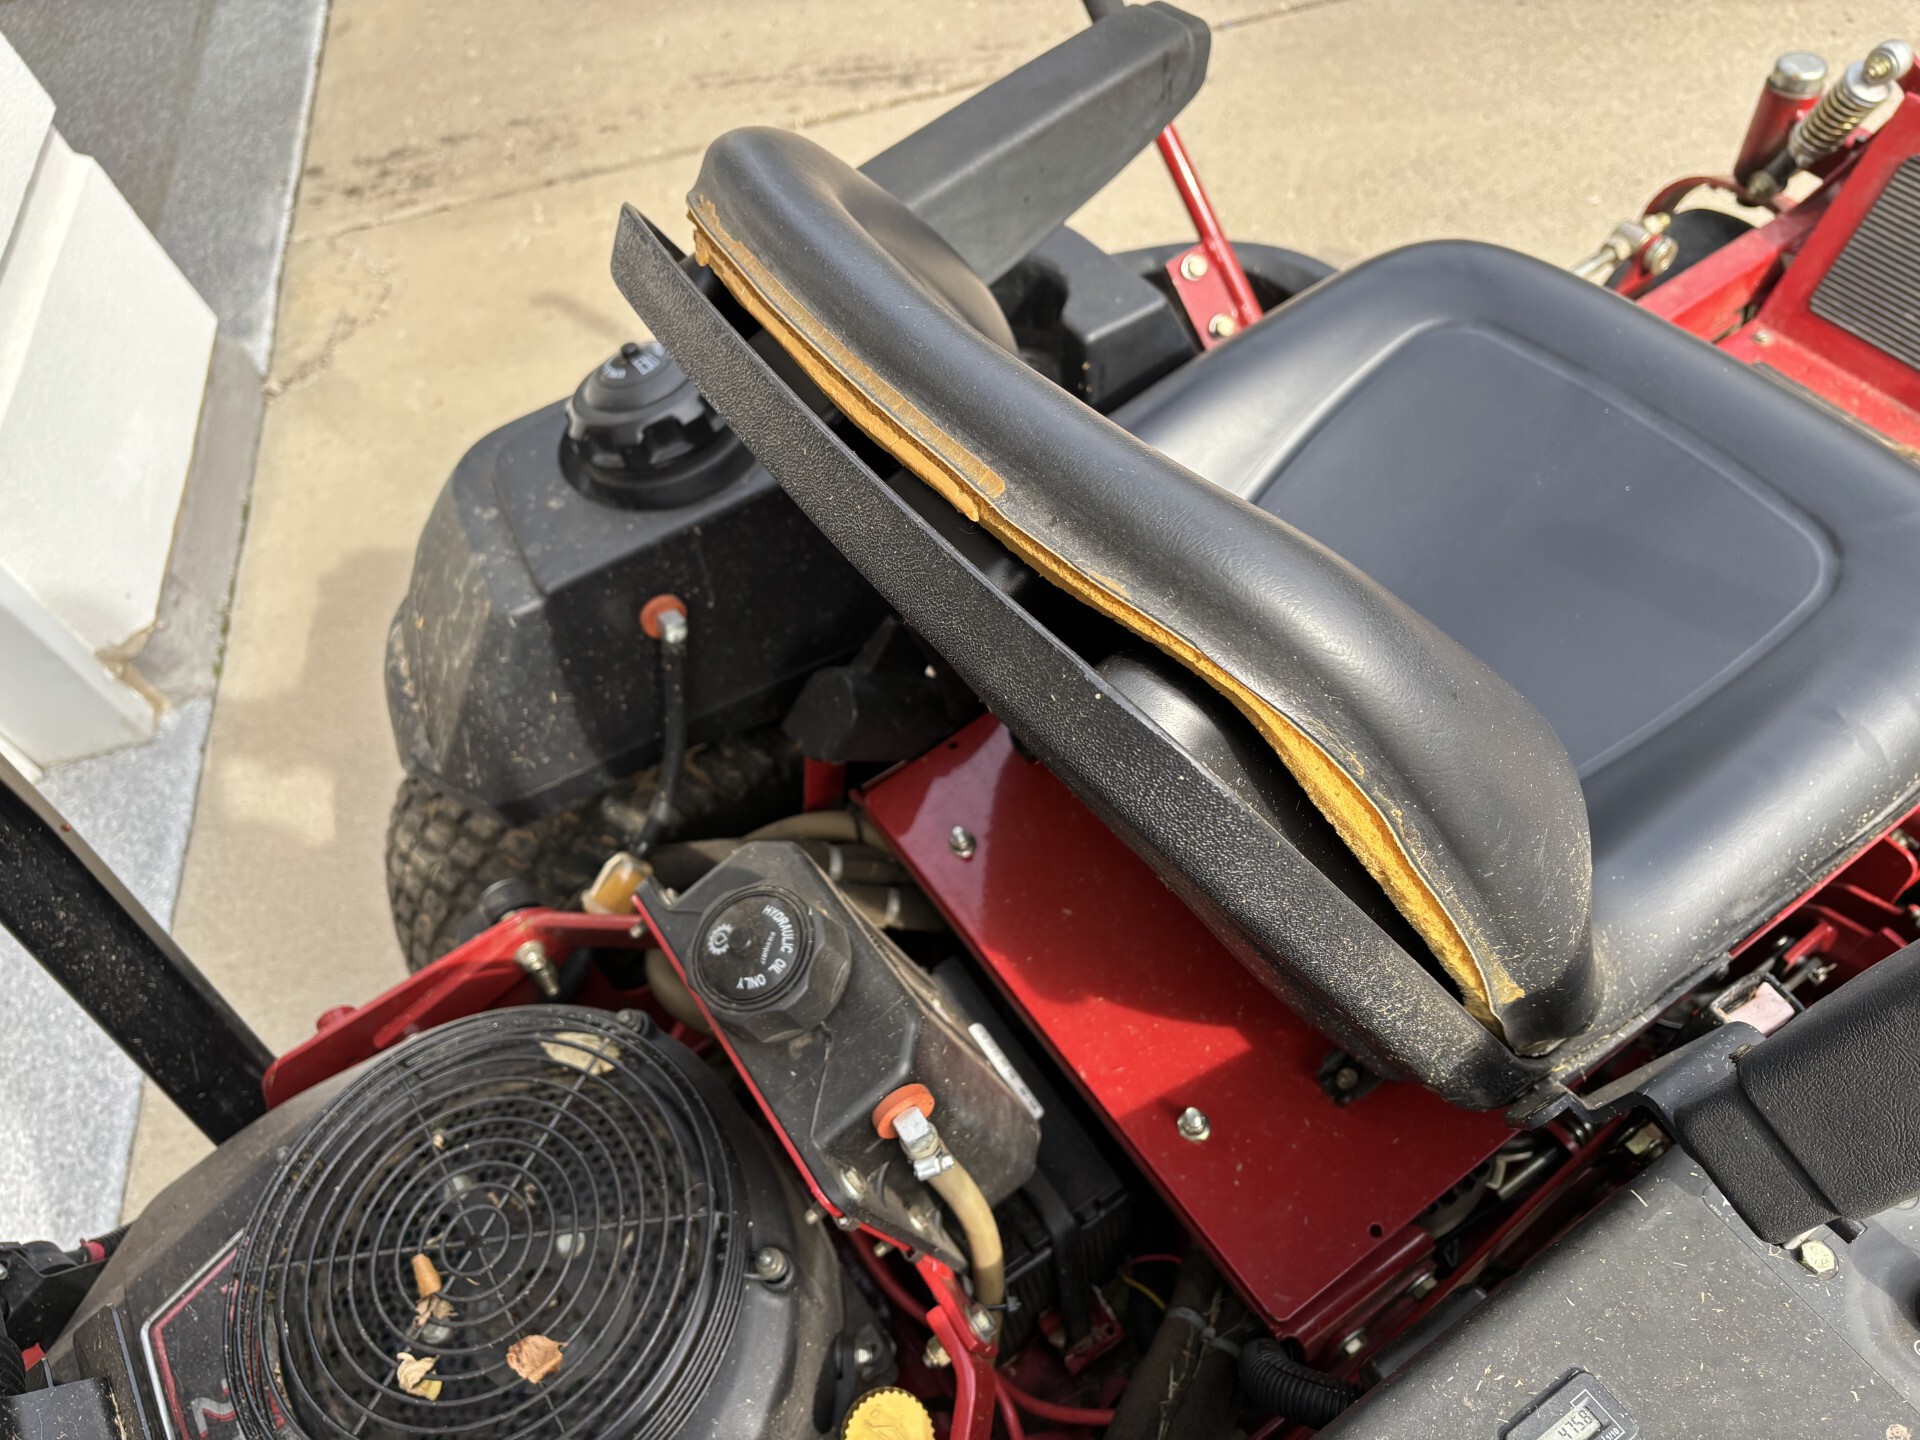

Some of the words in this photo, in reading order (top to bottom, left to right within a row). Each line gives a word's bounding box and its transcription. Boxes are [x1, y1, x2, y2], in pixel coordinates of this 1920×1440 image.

[762, 905, 794, 954] HYDRAULIC
[767, 958, 787, 974] OIL
[736, 973, 767, 990] ONLY
